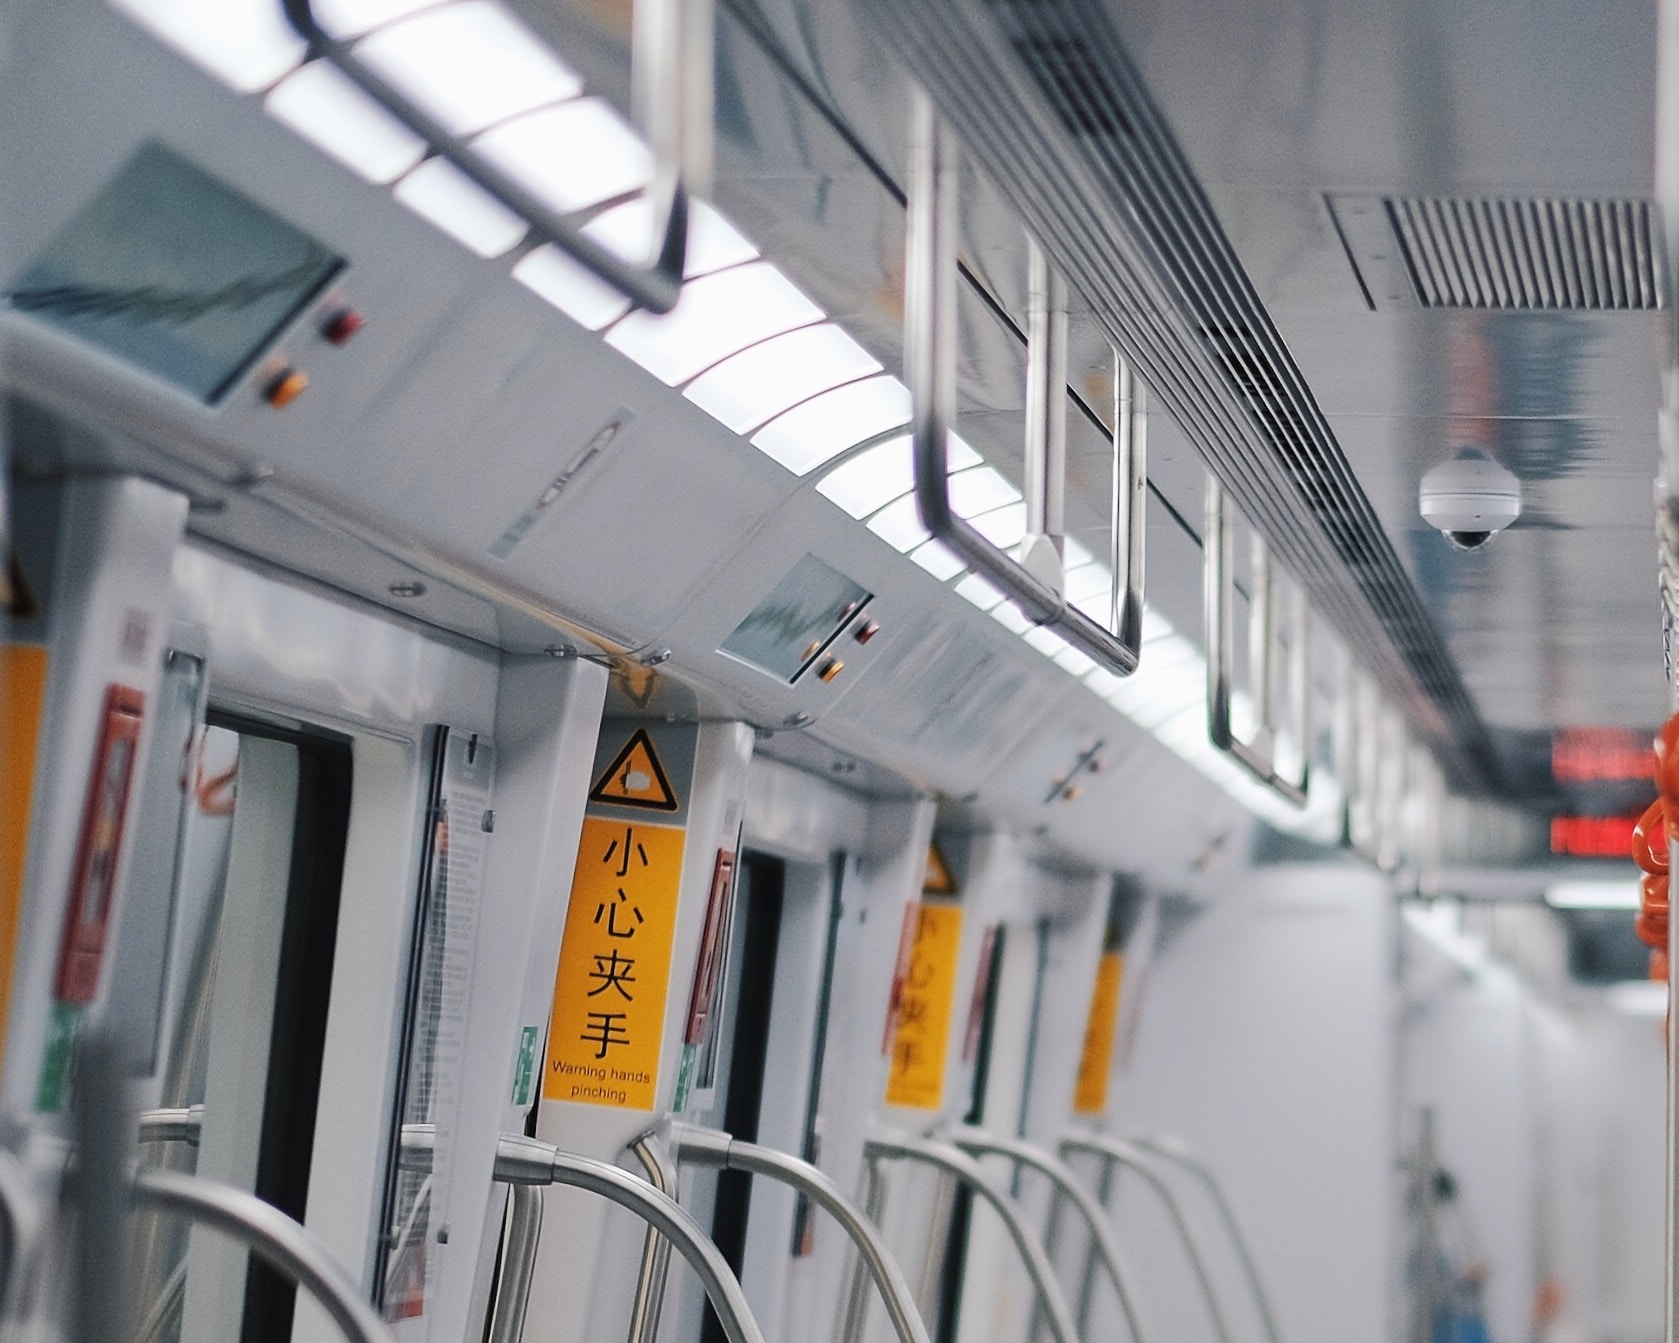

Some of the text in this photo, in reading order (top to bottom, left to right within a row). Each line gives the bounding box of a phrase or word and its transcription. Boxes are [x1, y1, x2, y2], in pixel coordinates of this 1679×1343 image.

[580, 828, 649, 1059] 小心夹手
[553, 1060, 650, 1083] Warning hands
[571, 1085, 626, 1104] pinching
